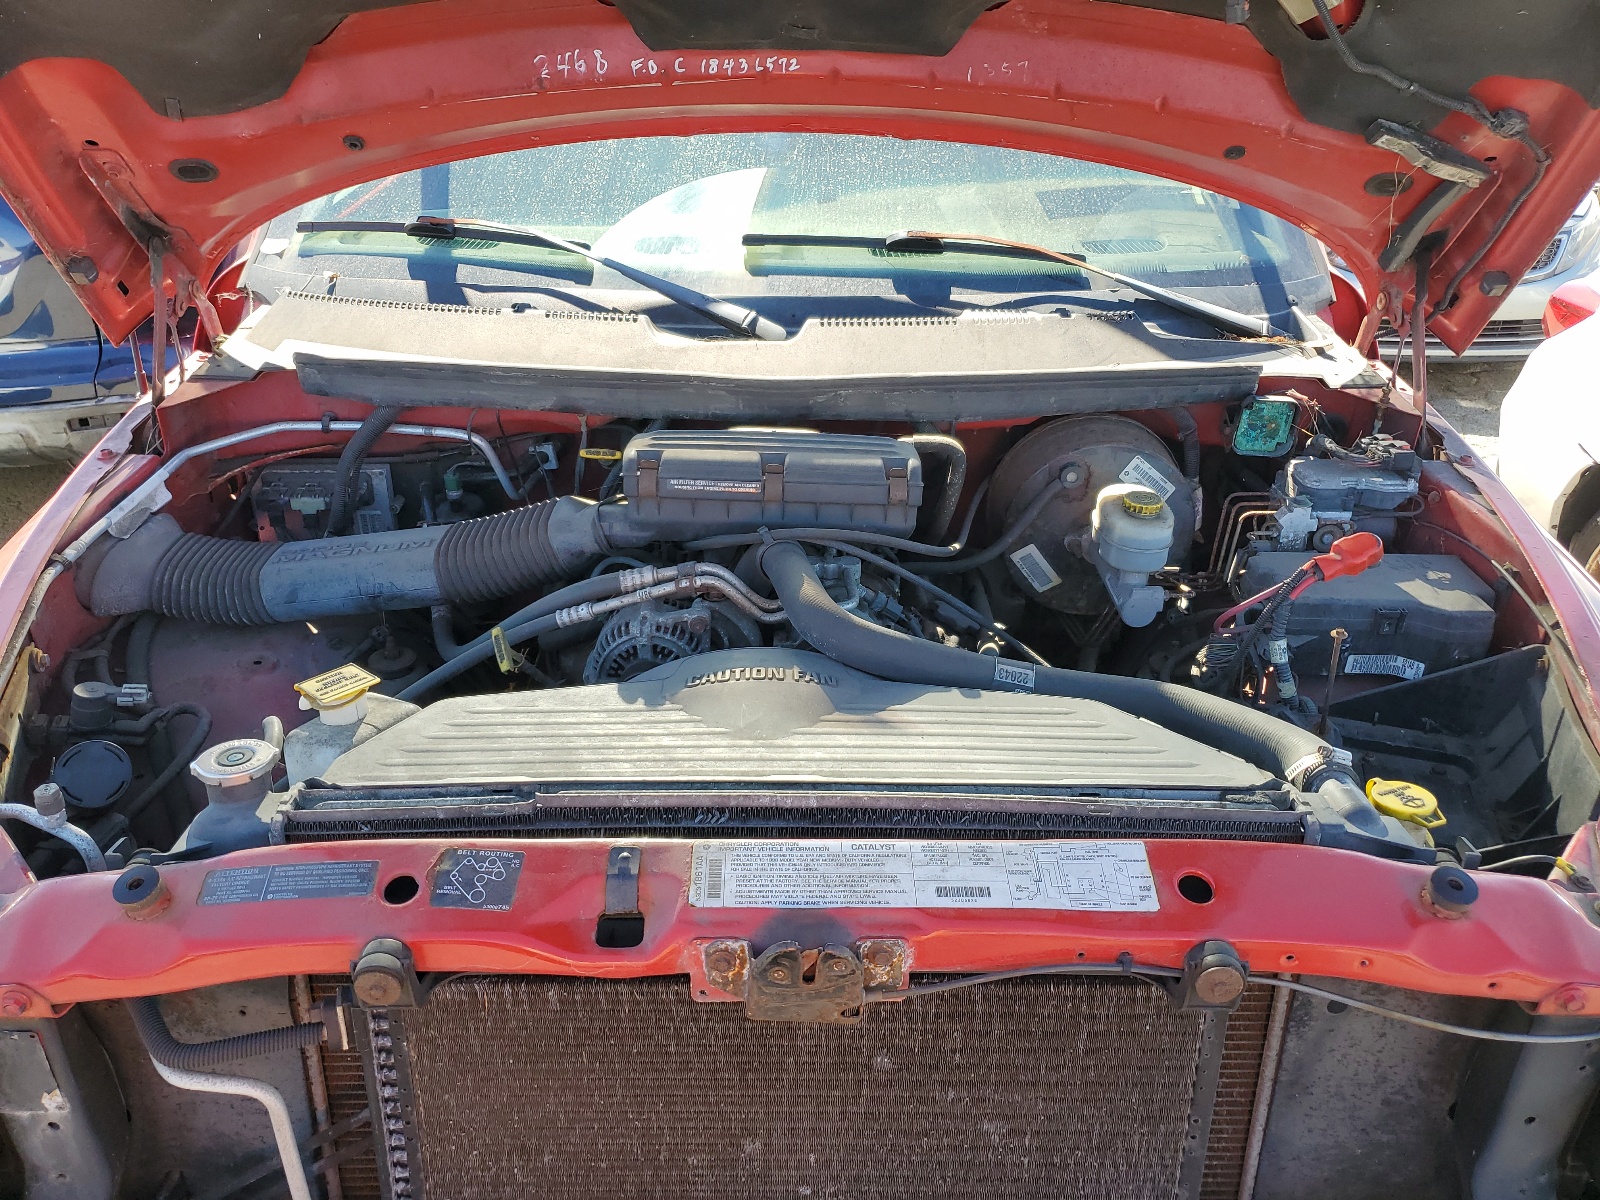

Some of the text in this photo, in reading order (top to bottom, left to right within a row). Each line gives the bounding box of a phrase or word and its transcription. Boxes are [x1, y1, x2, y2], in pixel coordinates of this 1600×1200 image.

[674, 57, 686, 73] C
[685, 665, 839, 688] CAUTION FAN
[998, 667, 1029, 684] 22043
